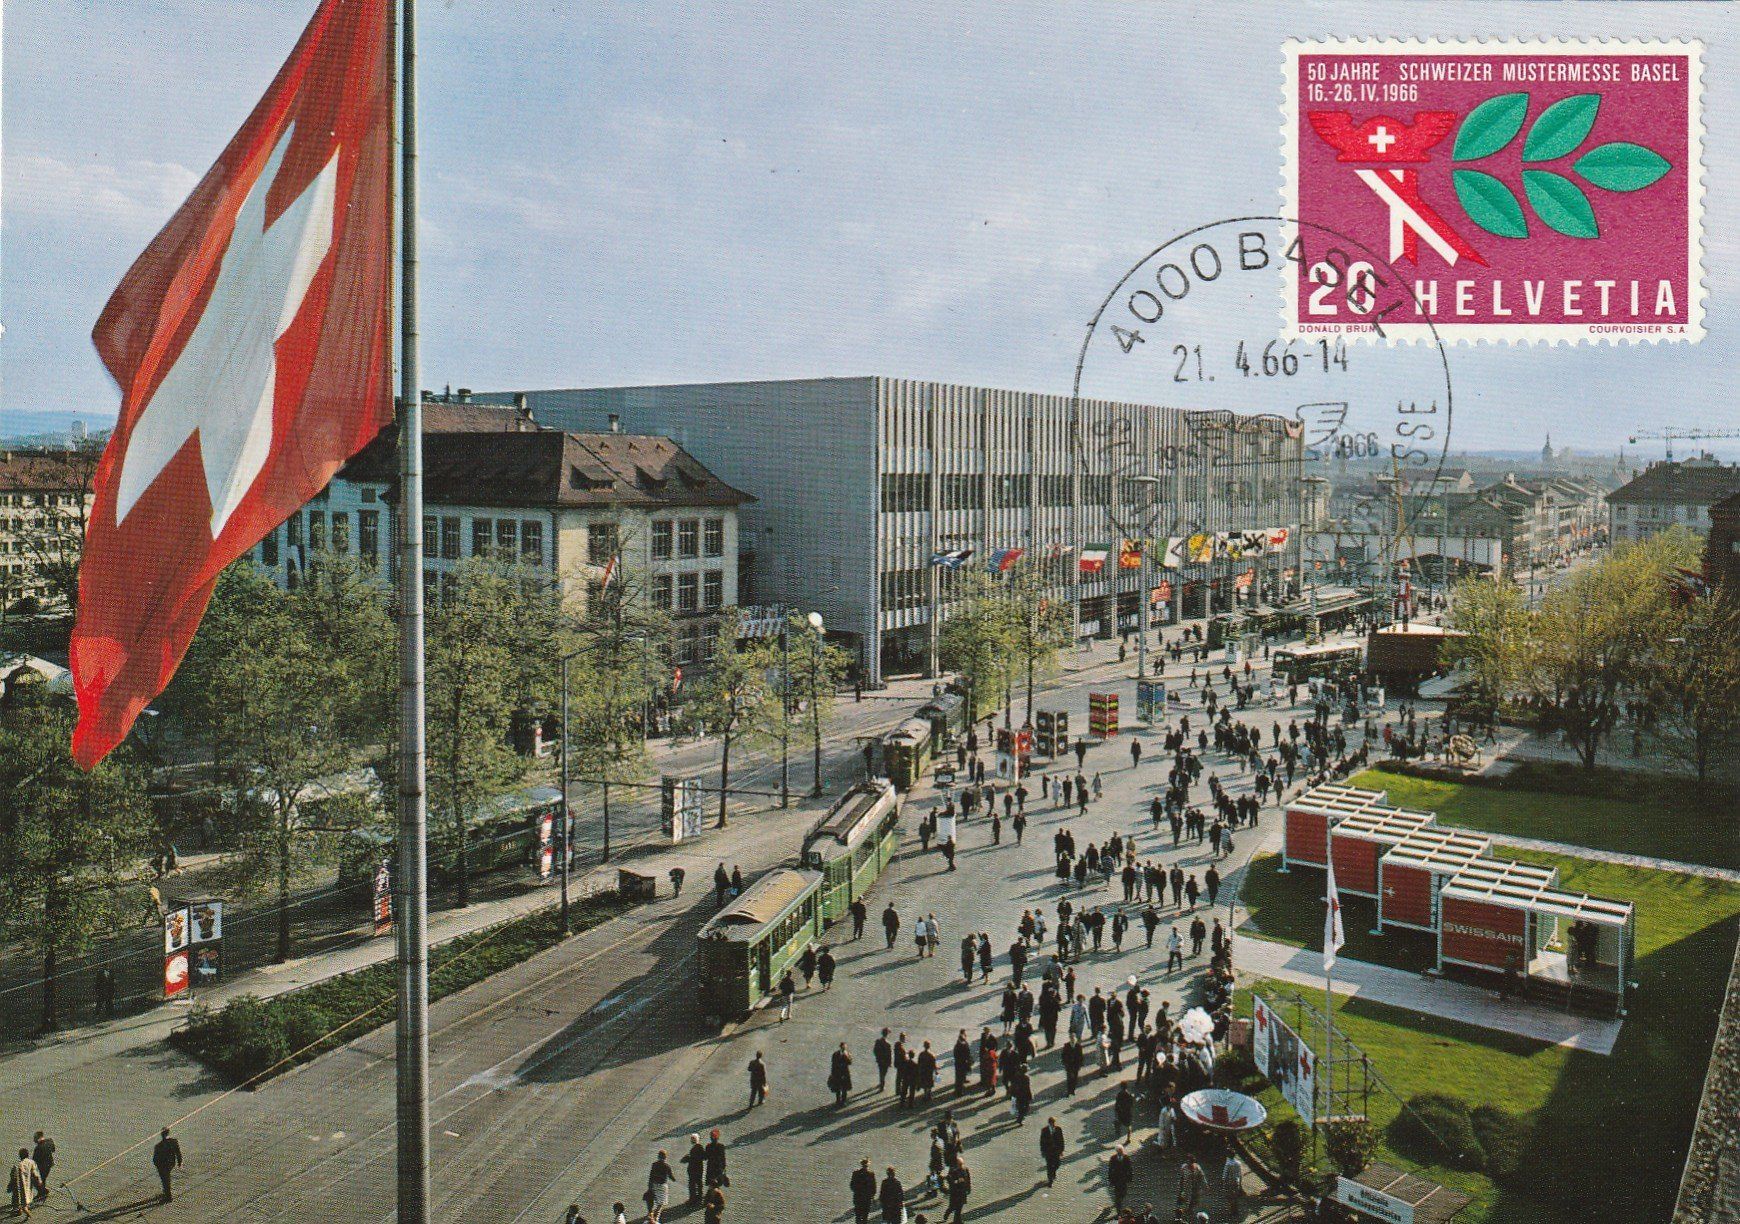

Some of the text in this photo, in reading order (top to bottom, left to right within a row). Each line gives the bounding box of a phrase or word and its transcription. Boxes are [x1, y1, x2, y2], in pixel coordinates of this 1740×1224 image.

[1308, 63, 1680, 82] 50 JAHRE SCHWEIZER MUSTERMESSE BASEL
[1383, 84, 1418, 102] 1966
[1110, 232, 1403, 354] 4000 BASEL
[1308, 261, 1375, 315] 20
[1415, 280, 1677, 316] HELVETIA
[1299, 325, 1341, 333] DONALD
[1589, 325, 1662, 333] COURVOISIER
[1443, 921, 1524, 947] SWISSAIR
